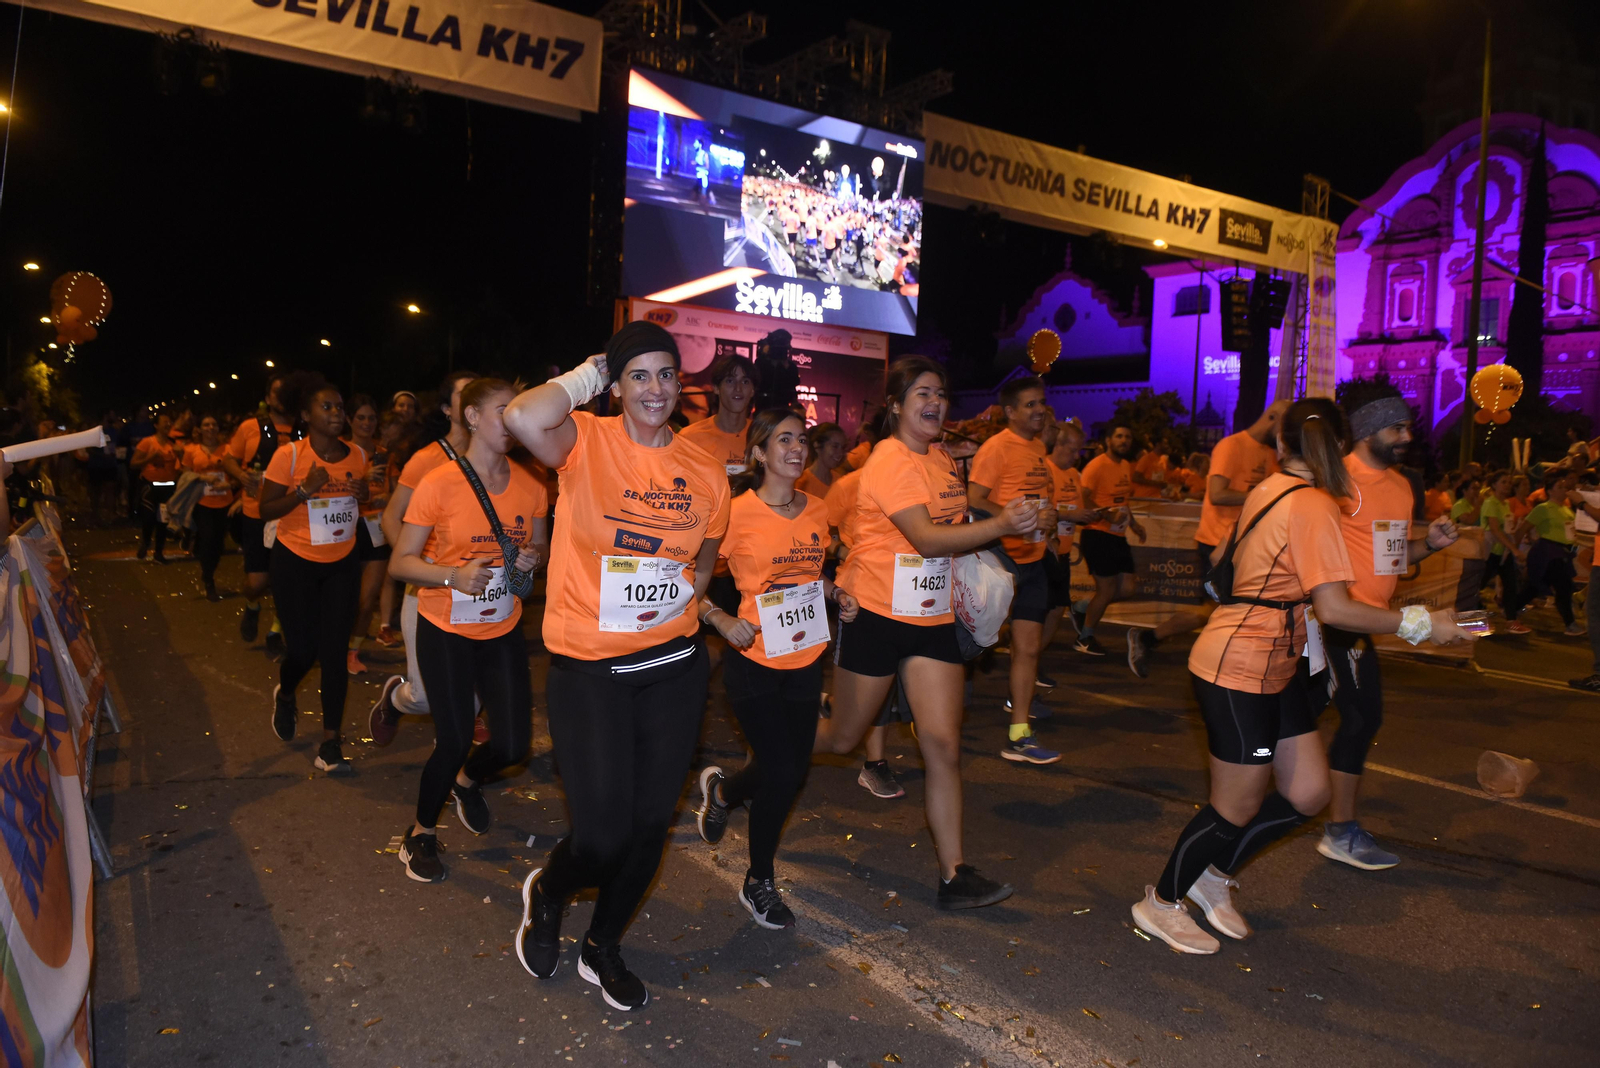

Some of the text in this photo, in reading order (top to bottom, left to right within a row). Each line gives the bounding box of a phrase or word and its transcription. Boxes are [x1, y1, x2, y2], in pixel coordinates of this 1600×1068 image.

[252, 0, 462, 51] EVILLA
[929, 140, 1066, 198] NOCTURNA
[1072, 178, 1159, 221] SEVILLA
[644, 492, 692, 502] NOCTURNA
[323, 511, 352, 525] 14605
[772, 556, 806, 564] SEVILLA
[912, 575, 945, 591] 14623
[624, 583, 679, 602] 10270
[1144, 586, 1196, 597] DE SEVILLA
[778, 604, 815, 627] 15118
